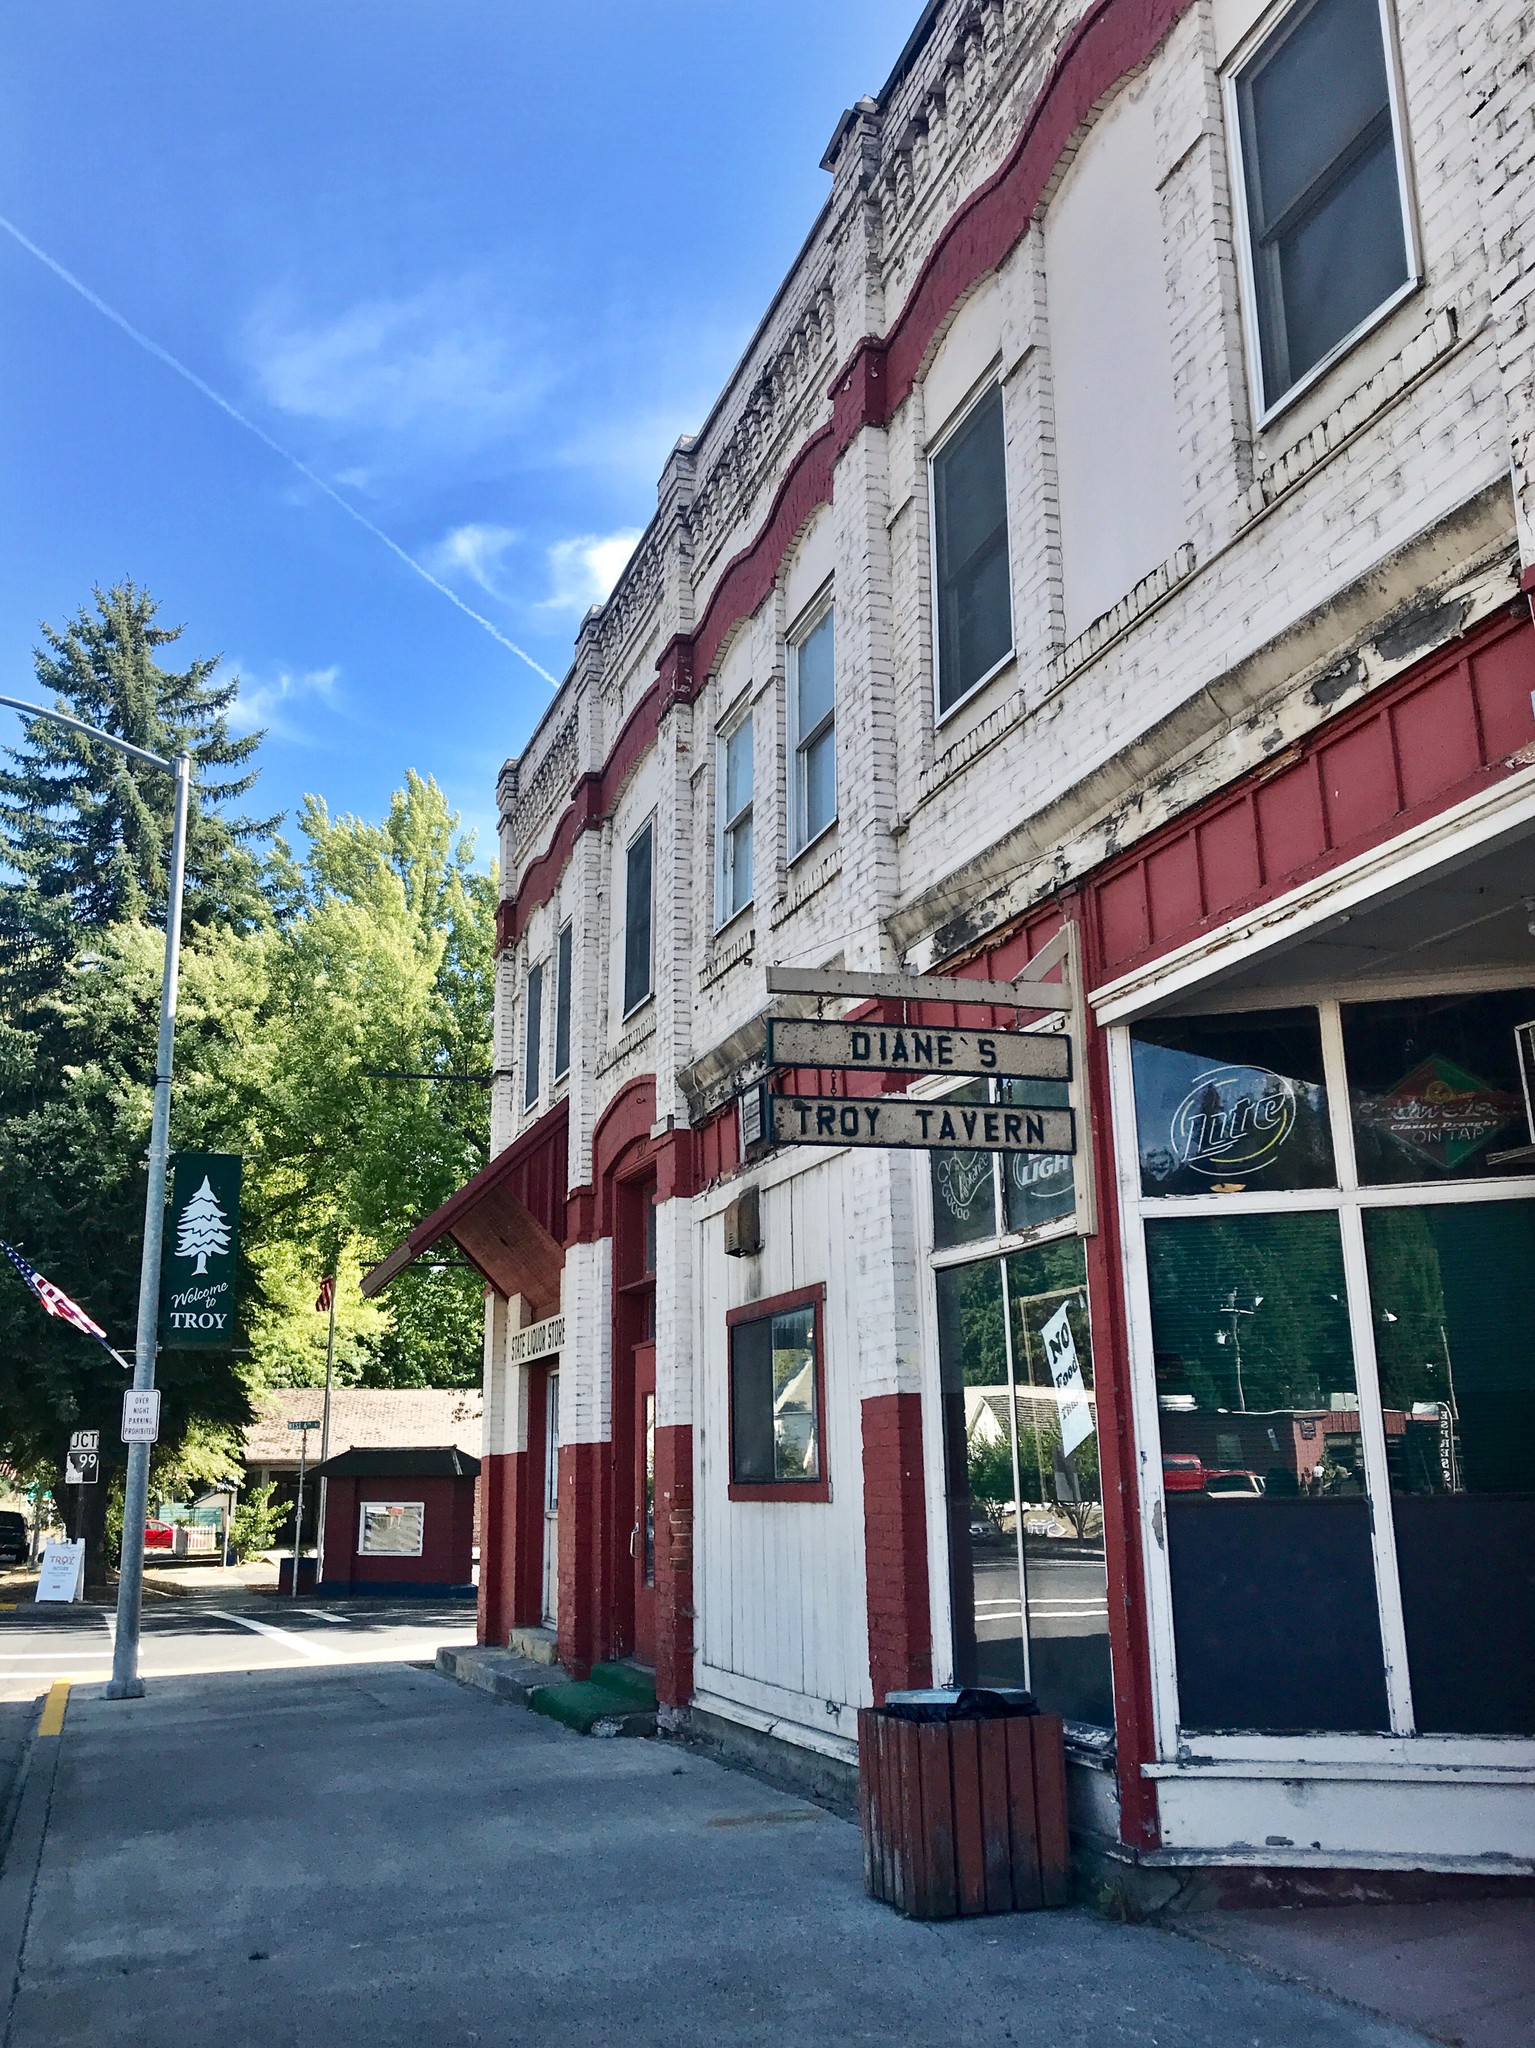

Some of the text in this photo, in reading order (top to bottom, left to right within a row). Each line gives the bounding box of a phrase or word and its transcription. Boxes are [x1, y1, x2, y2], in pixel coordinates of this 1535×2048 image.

[851, 1031, 997, 1068] DIANE'S
[798, 1104, 881, 1137] TROY
[915, 1109, 1045, 1144] TAVERN
[1412, 1126, 1485, 1144] ON TAP
[1021, 1154, 1069, 1187] LIGH
[170, 1282, 229, 1309] Welcome
[205, 1296, 217, 1309] to
[169, 1312, 228, 1330] TROY
[511, 1317, 564, 1361] STATE LIQUOR STORE
[1048, 1321, 1070, 1365] NO
[134, 1396, 150, 1405] OVER
[132, 1407, 150, 1415] NIGHT
[128, 1417, 153, 1425] PARKING
[124, 1427, 155, 1435] PROHIBITED
[71, 1433, 98, 1449] JCT
[79, 1453, 97, 1469] 99
[50, 1555, 75, 1565] TROY
